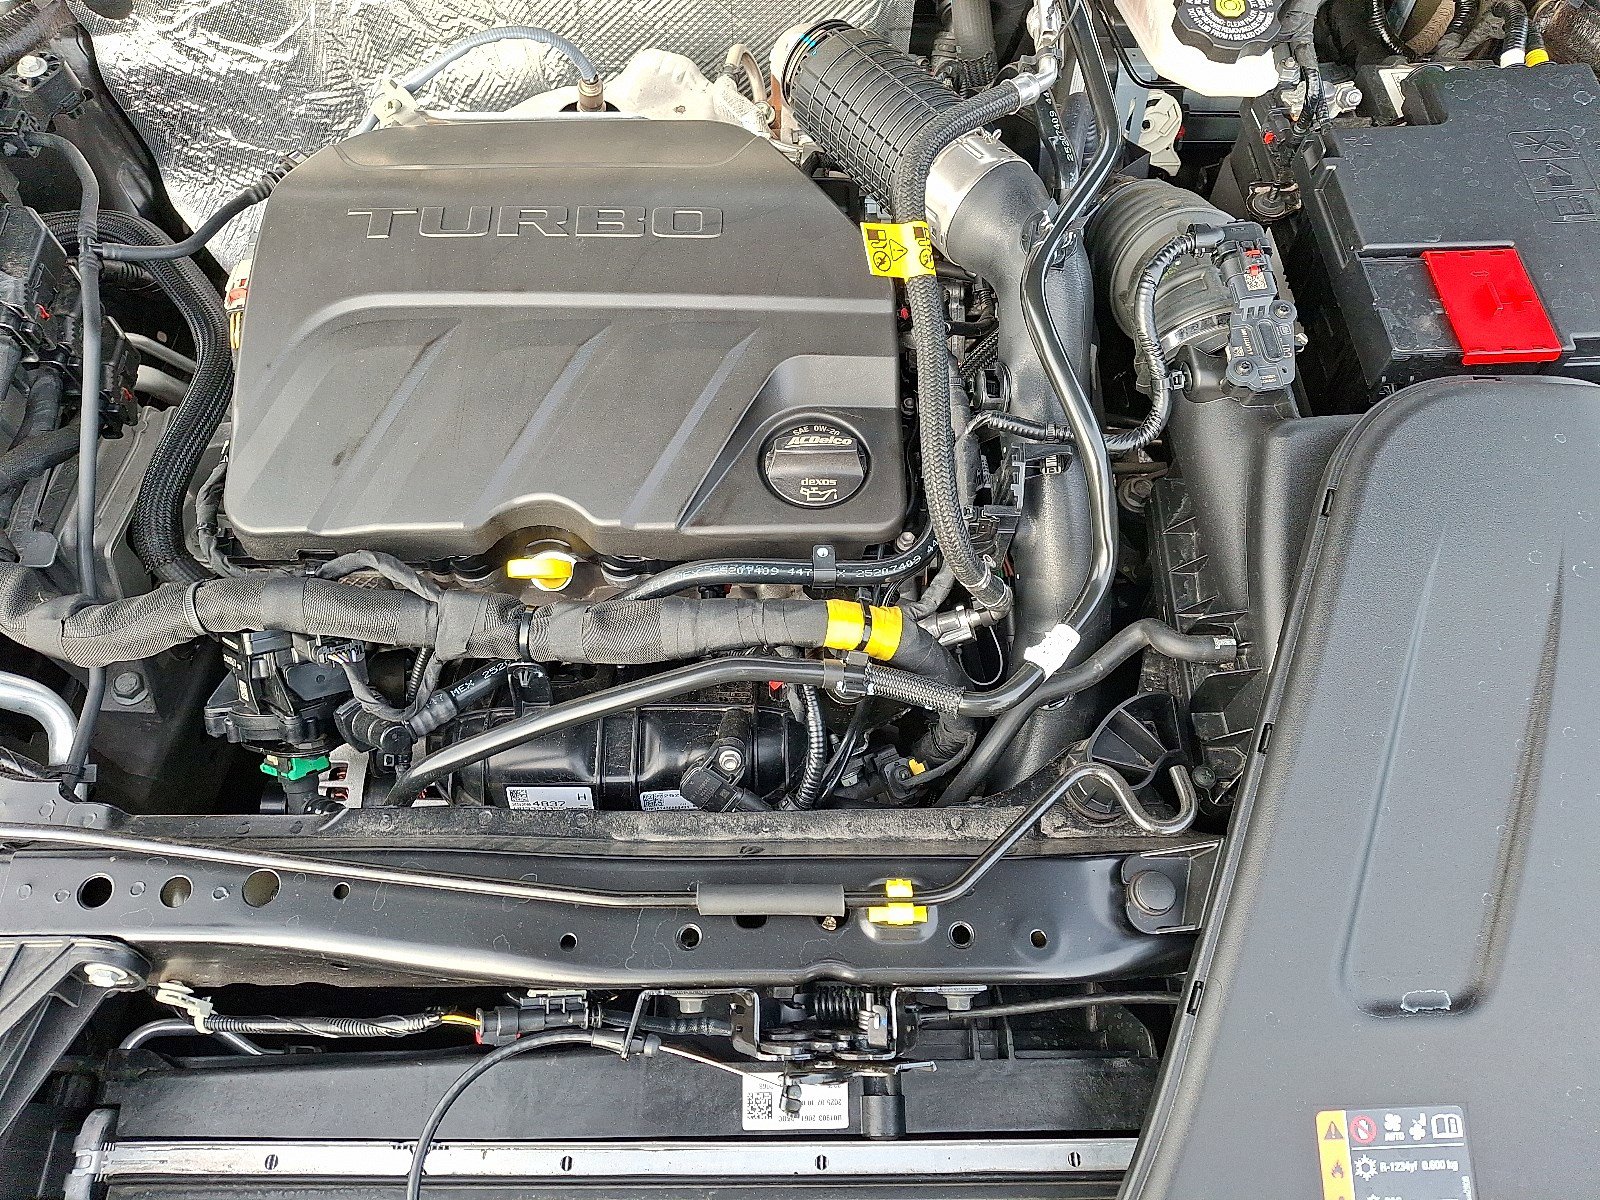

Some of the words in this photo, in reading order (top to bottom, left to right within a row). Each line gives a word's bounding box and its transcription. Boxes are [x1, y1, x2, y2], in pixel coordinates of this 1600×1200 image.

[1049, 110, 1075, 162] 25207409
[347, 205, 724, 239] TURBO
[792, 425, 810, 437] SAE
[786, 436, 853, 449] ACDelco
[800, 478, 838, 487] dexos
[855, 554, 922, 578] 25207409
[449, 679, 476, 698] MEX
[1379, 1160, 1418, 1174] R-1234yf
[1446, 1159, 1459, 1172] kg
